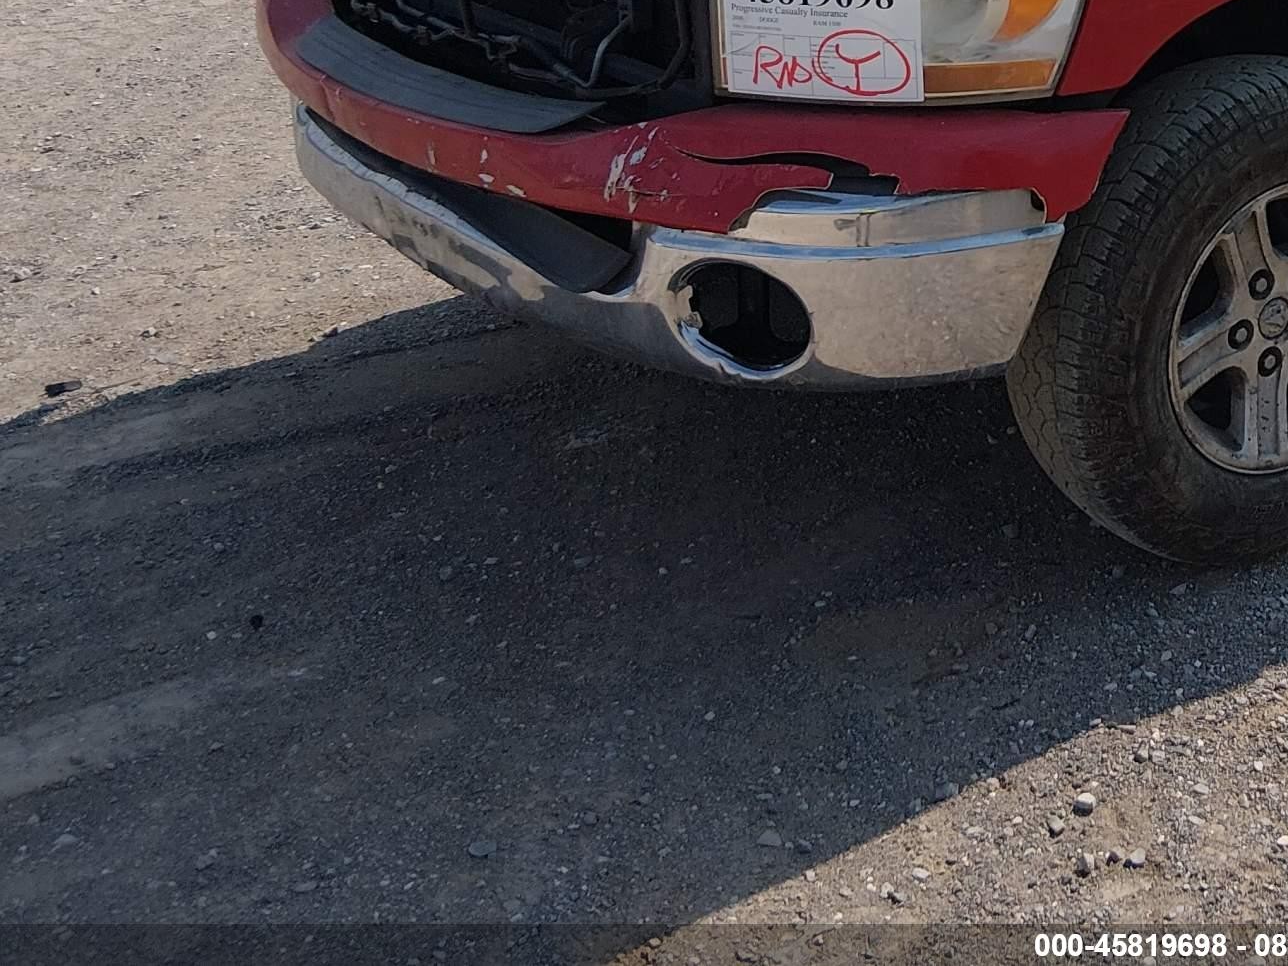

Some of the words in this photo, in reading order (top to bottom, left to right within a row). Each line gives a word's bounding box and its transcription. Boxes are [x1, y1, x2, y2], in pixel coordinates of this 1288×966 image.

[731, 3, 773, 15] Progressive
[774, 6, 808, 19] Casualty
[810, 8, 849, 18] Insurance
